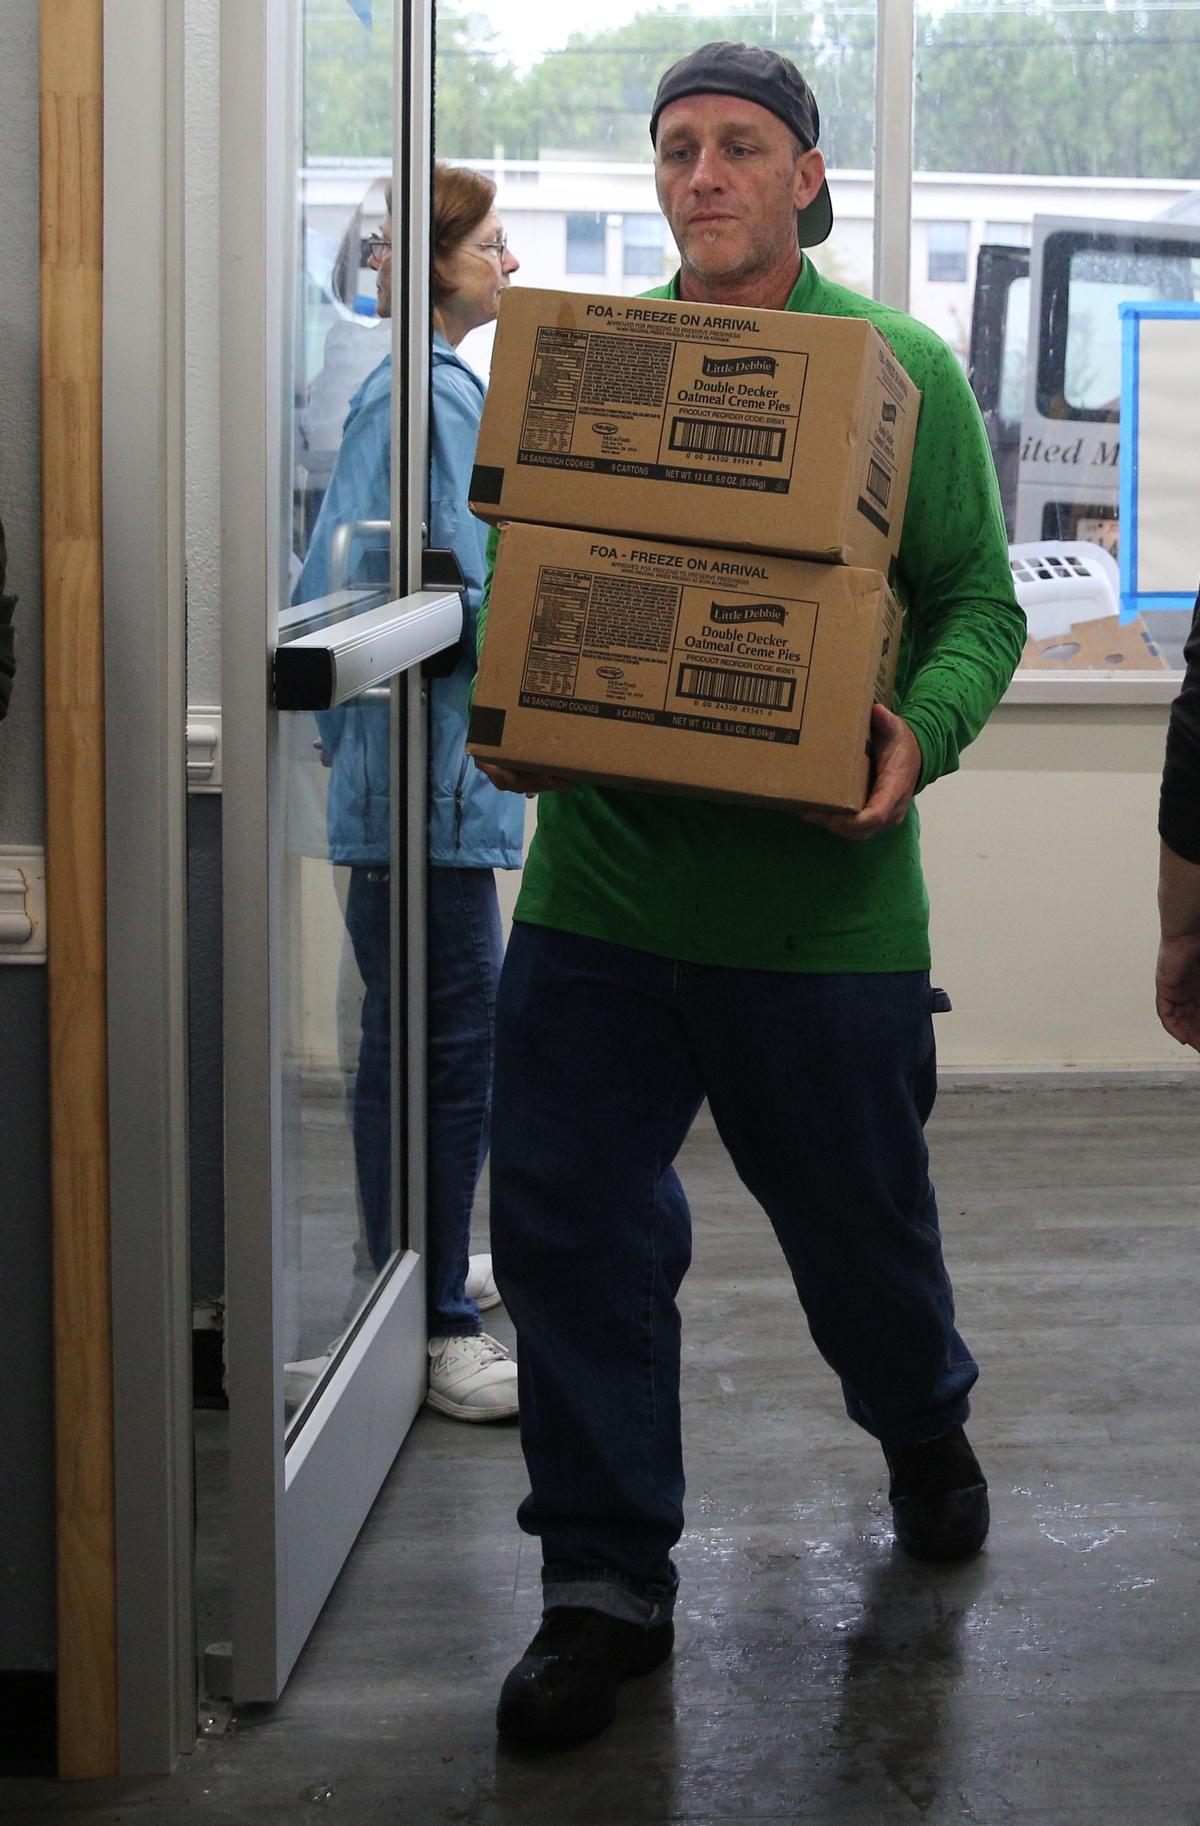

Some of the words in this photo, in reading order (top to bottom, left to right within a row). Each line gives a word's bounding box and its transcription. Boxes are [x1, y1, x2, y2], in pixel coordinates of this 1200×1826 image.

[586, 304, 613, 318] FOA
[625, 308, 676, 324] FREEZE
[680, 314, 701, 326] ON
[703, 316, 760, 332] ARRIVAL
[606, 320, 634, 329] APPROVED
[647, 323, 672, 332] FREEZING
[681, 327, 709, 336] PRESERVE
[709, 330, 741, 339] FRESHNESS
[706, 363, 733, 373] Little
[735, 360, 772, 372] Debbie
[693, 379, 734, 394] Double
[737, 384, 778, 398] Decker
[677, 389, 725, 405] Oatmeal
[728, 395, 765, 409] Creme
[768, 399, 791, 412] Pies
[679, 408, 711, 418] PRODUCT
[711, 411, 743, 421] REORDER
[744, 415, 765, 423] CODE:
[520, 453, 528, 461] 54
[529, 454, 564, 467] SANDWICH
[565, 458, 595, 469] COOKIES
[707, 455, 729, 463] 24300
[611, 464, 616, 472] 9
[616, 464, 649, 475] CARTONS
[665, 469, 679, 478] NET
[680, 470, 692, 479] WT.
[694, 472, 702, 481] 13
[715, 475, 726, 484] 5.0
[740, 478, 766, 490] (6.04kg)
[590, 545, 618, 559] FOA
[630, 550, 684, 567] FREEZE
[687, 557, 708, 572] ON
[710, 561, 769, 580] ARRIVAL
[610, 562, 639, 571] APPROVED
[640, 564, 652, 572] FOR
[652, 566, 678, 576] FREEZING
[688, 571, 716, 580] PRESERVE
[717, 575, 749, 585] FRESHNESS
[714, 609, 742, 620] Little
[744, 609, 781, 620] Debbie
[701, 625, 743, 642] Double
[746, 632, 788, 648] Decker
[684, 636, 733, 653] Oatmeal
[736, 643, 775, 658] Creme
[778, 648, 801, 662] Pies
[686, 654, 719, 665] PRODUCT
[720, 658, 752, 669] REORDER
[753, 663, 774, 672] CODE:
[522, 695, 530, 704] 54
[531, 696, 567, 709] SANDWICH
[568, 701, 600, 713] COOKIES
[715, 702, 738, 712] 24300
[741, 706, 763, 715] 89561
[616, 709, 621, 717] 9
[622, 709, 655, 721] CARTONS
[672, 716, 687, 726] NET
[688, 718, 700, 728] WT.
[702, 720, 710, 729] 13
[724, 723, 735, 732] 5.0
[748, 726, 776, 739] (6.04kg)
